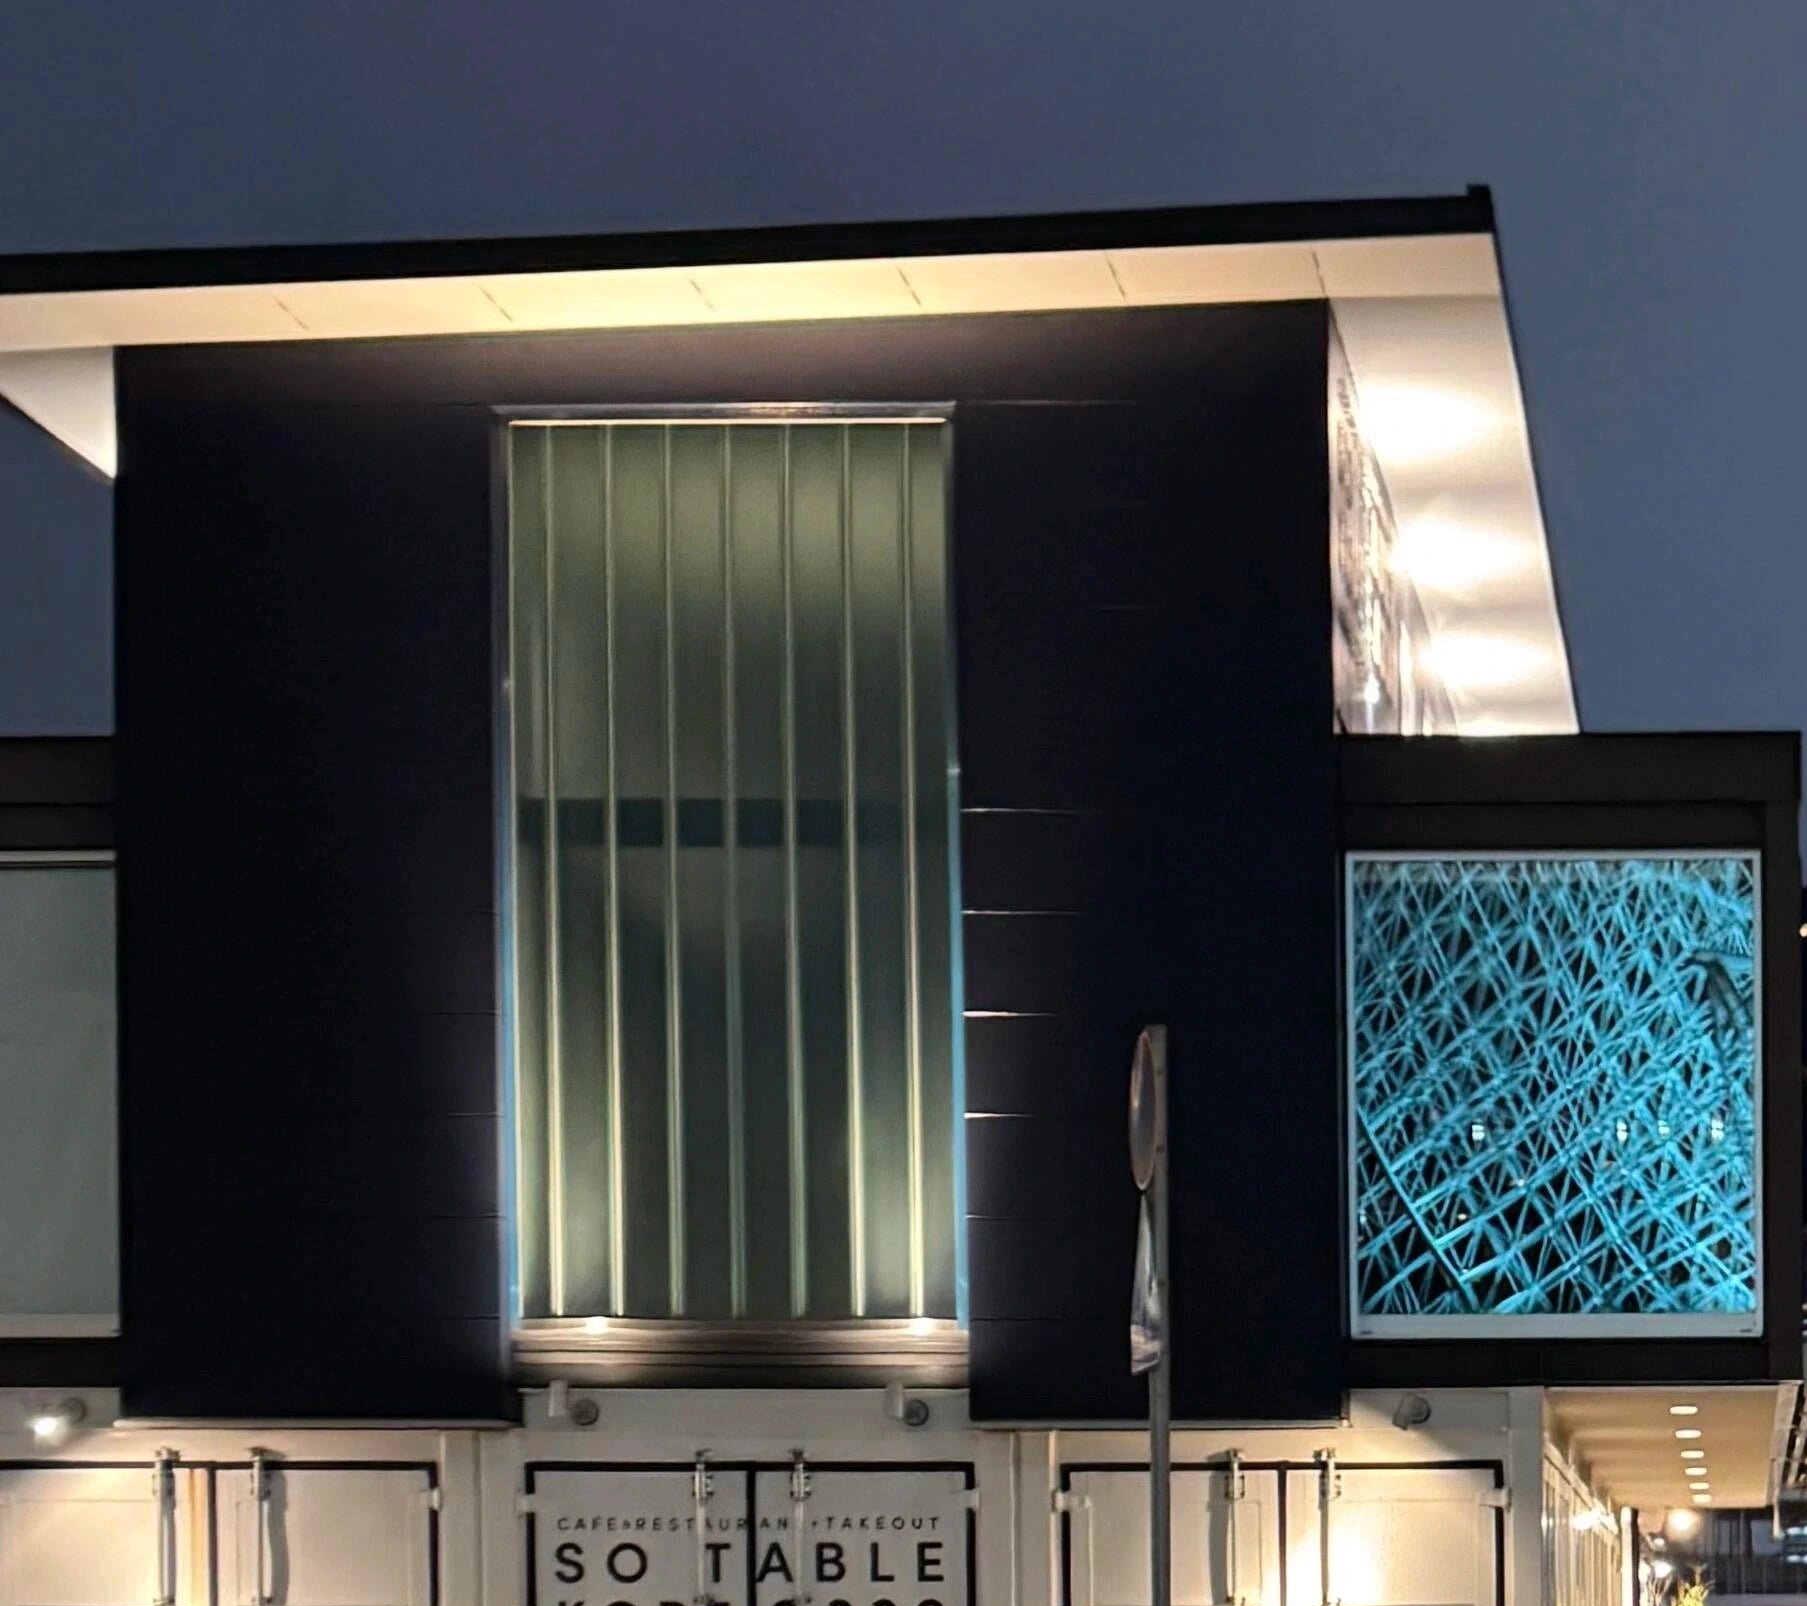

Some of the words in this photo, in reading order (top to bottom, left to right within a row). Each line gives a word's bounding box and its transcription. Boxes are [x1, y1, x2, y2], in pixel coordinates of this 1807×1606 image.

[557, 1517, 617, 1531] CAFE
[635, 1517, 789, 1531] RESTAURAN
[825, 1516, 940, 1531] TAKEOUT
[555, 1542, 648, 1584] SO
[703, 1541, 945, 1584] TABLE
